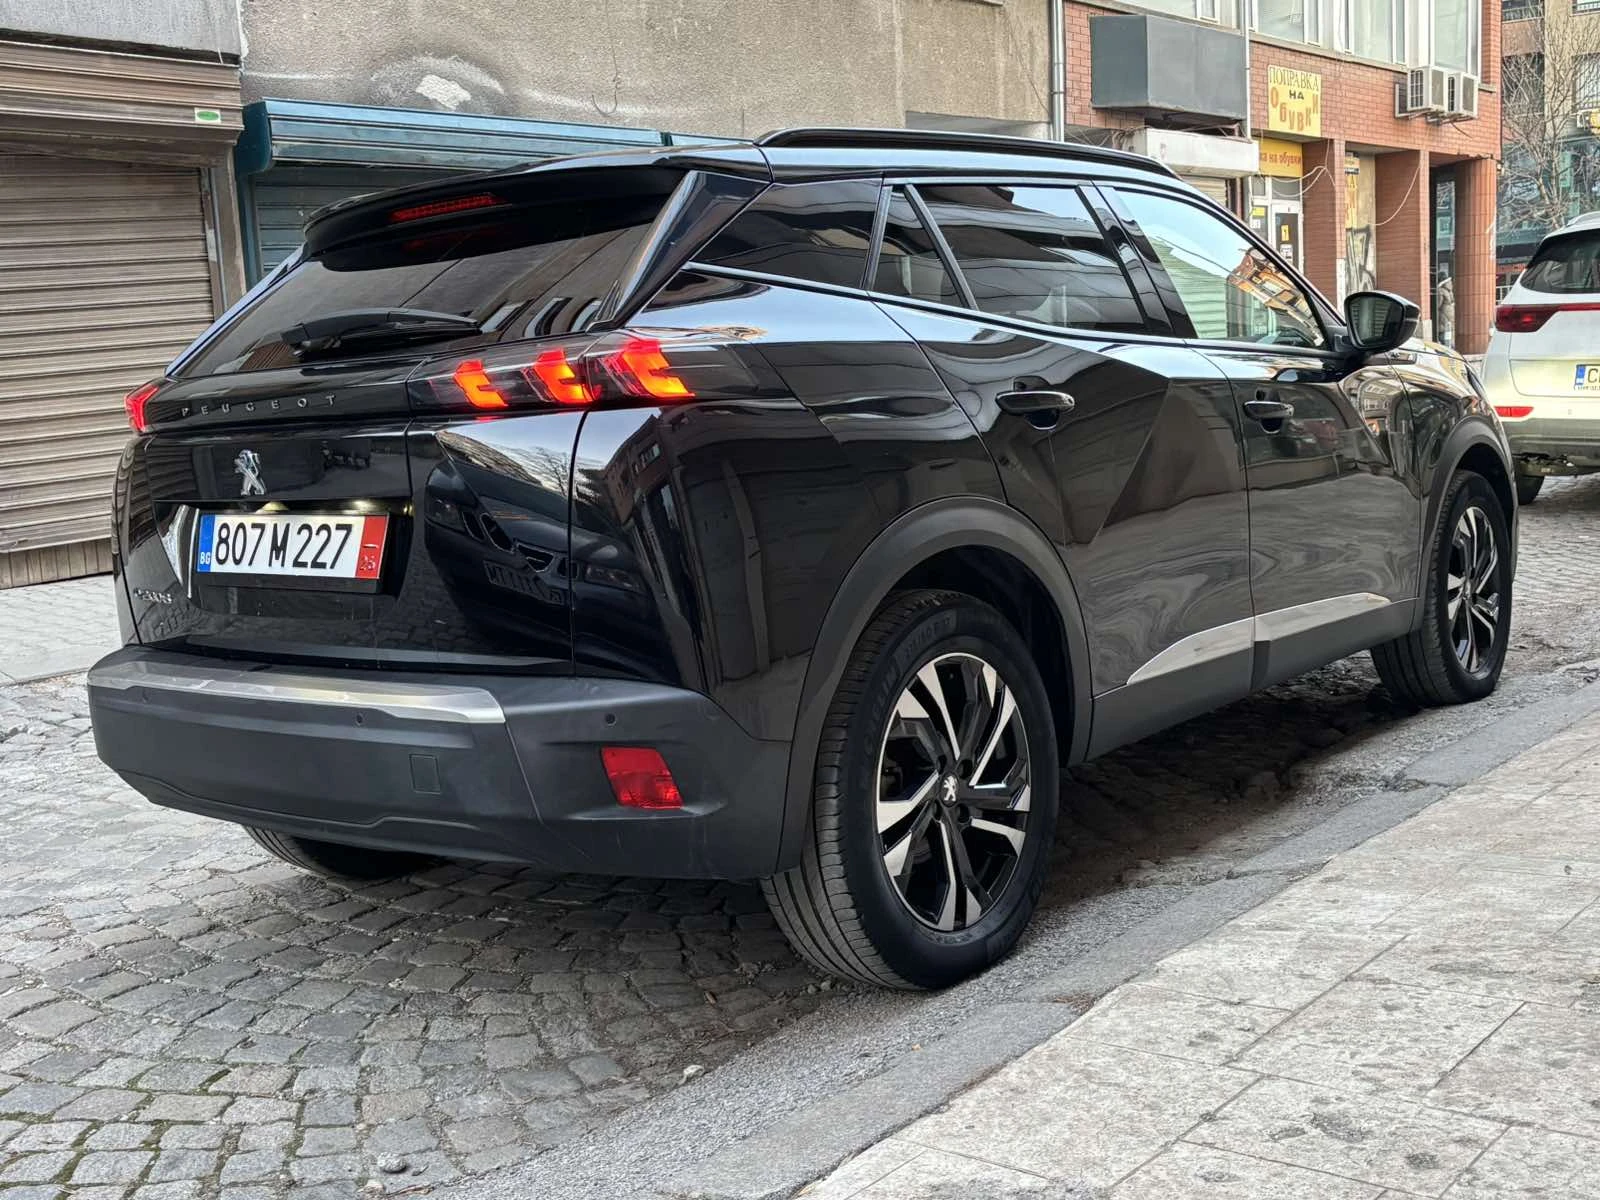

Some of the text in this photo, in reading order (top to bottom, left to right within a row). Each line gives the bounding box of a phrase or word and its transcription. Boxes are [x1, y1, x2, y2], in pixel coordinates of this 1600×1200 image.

[1269, 66, 1320, 92] ПОПРАВКА
[1289, 89, 1304, 100] НА
[181, 394, 336, 417] PEUGEOT
[215, 522, 353, 570] 807 M 227
[200, 551, 211, 565] BG
